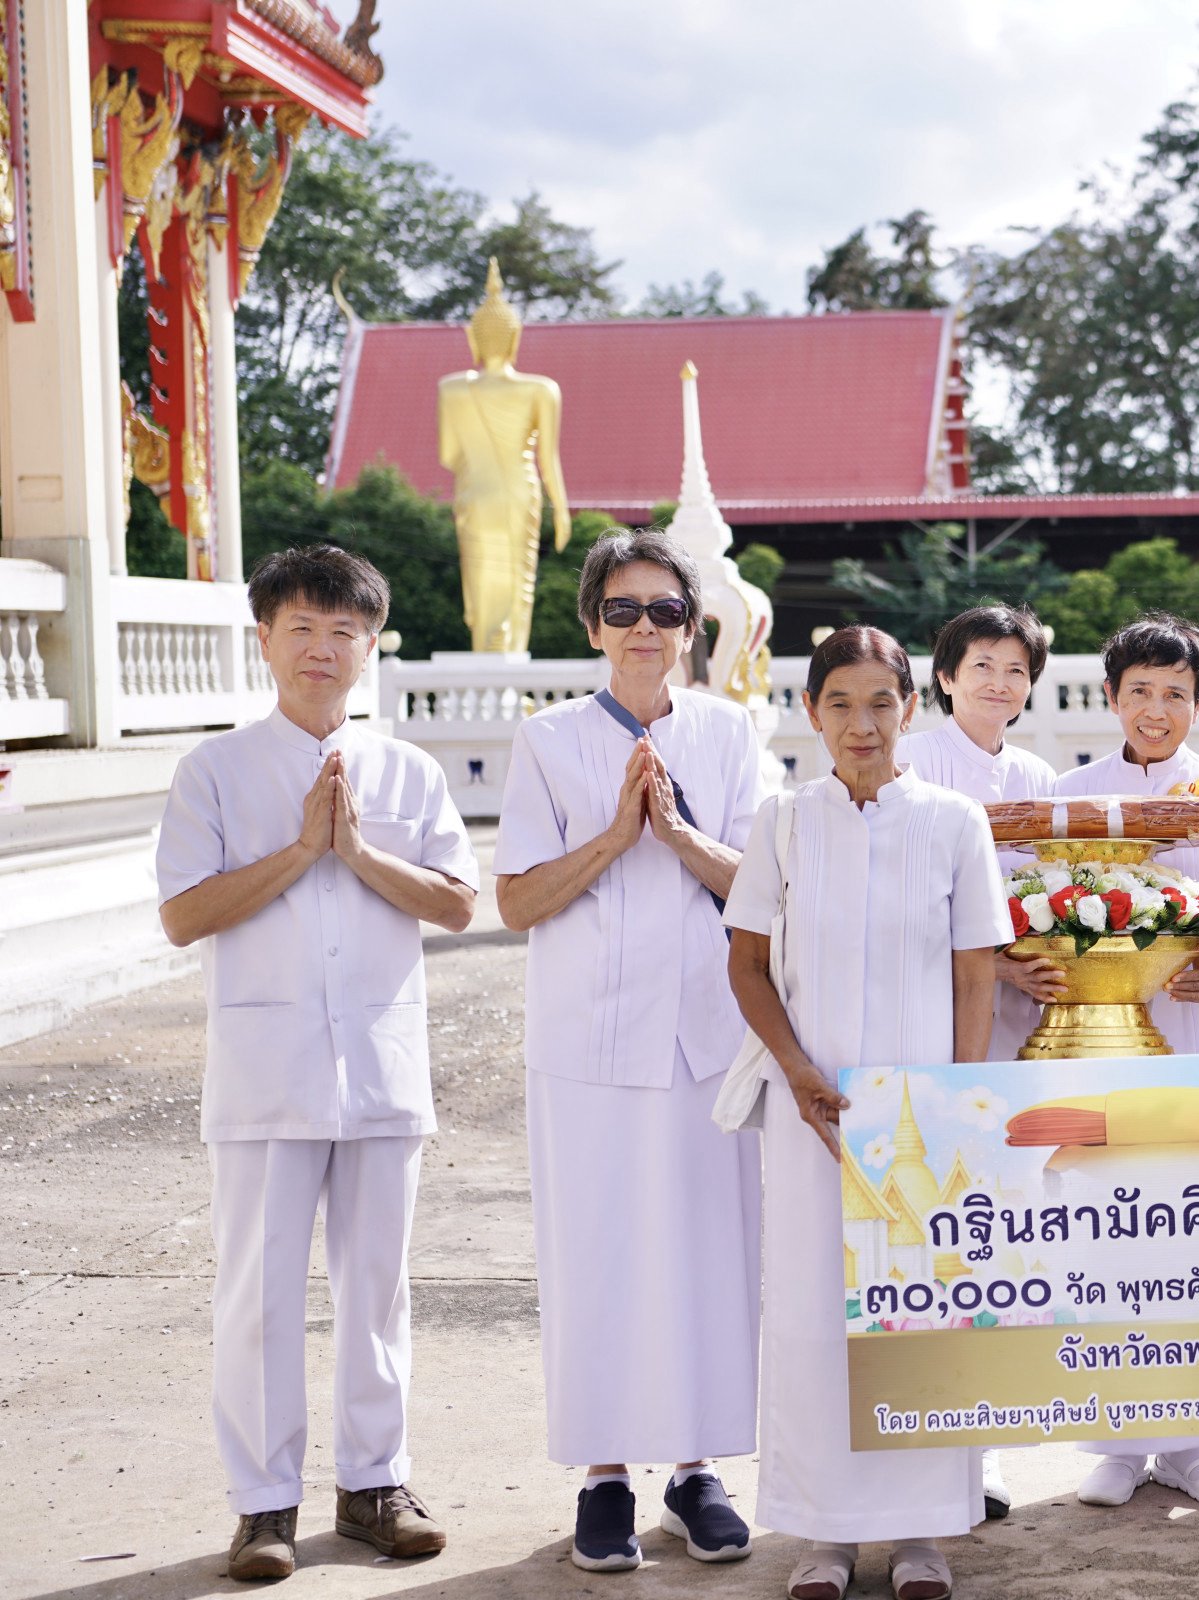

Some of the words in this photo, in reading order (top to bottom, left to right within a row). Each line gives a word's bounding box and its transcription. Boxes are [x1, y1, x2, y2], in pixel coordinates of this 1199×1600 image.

[866, 1278, 1052, 1319] ๓๐,๐๐๐
[1066, 1272, 1106, 1306] วัด
[876, 1407, 917, 1430] โดย
[927, 1396, 1098, 1432] คณะศิษยานุศิษย์
